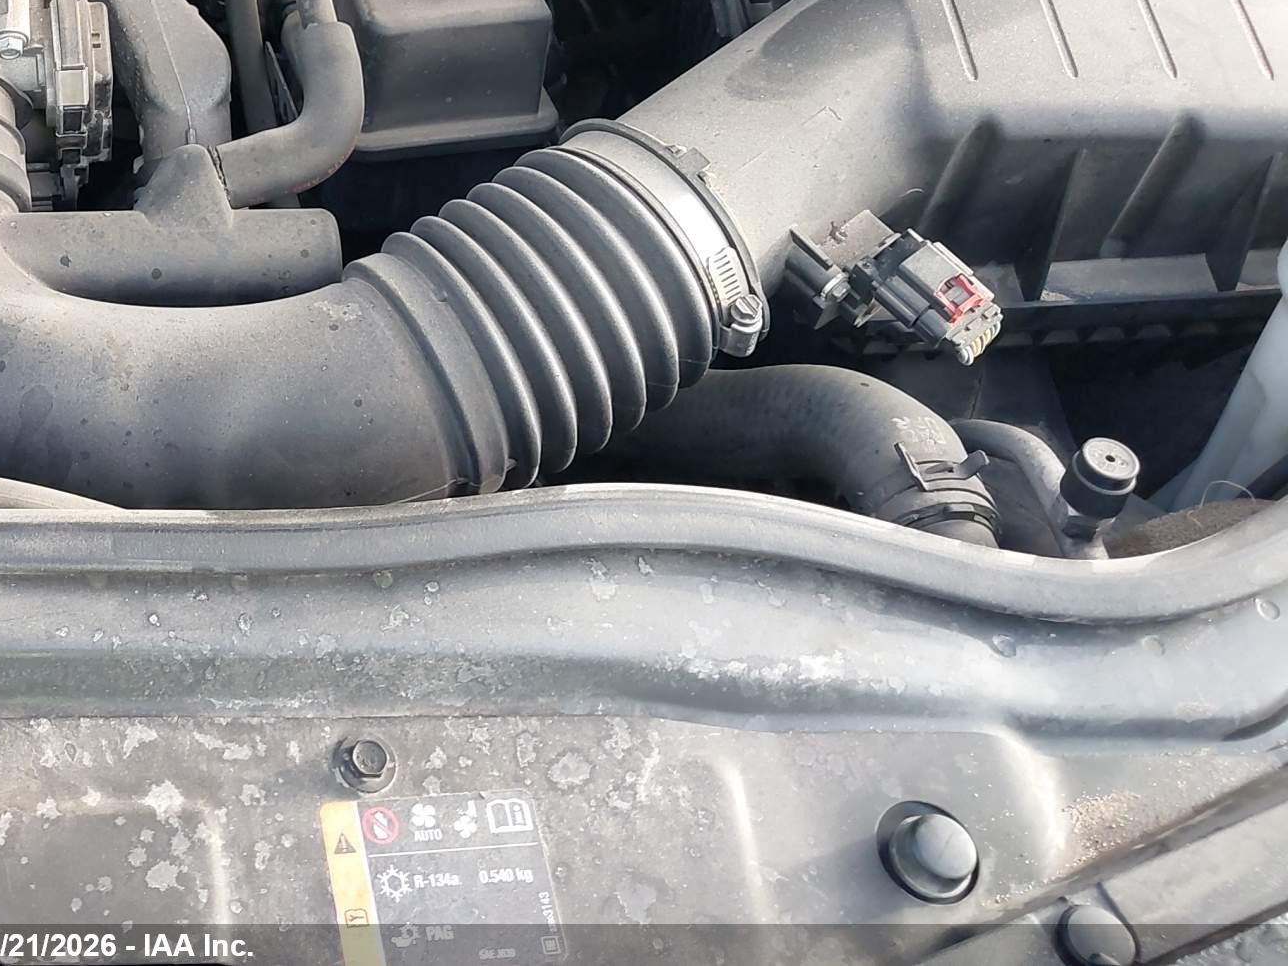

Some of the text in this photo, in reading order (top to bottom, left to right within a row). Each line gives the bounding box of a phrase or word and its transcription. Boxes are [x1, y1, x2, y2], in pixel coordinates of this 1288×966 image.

[413, 829, 443, 842] AUTO
[478, 869, 513, 884] 0.540
[513, 867, 534, 884] kg
[425, 925, 455, 941] PAG
